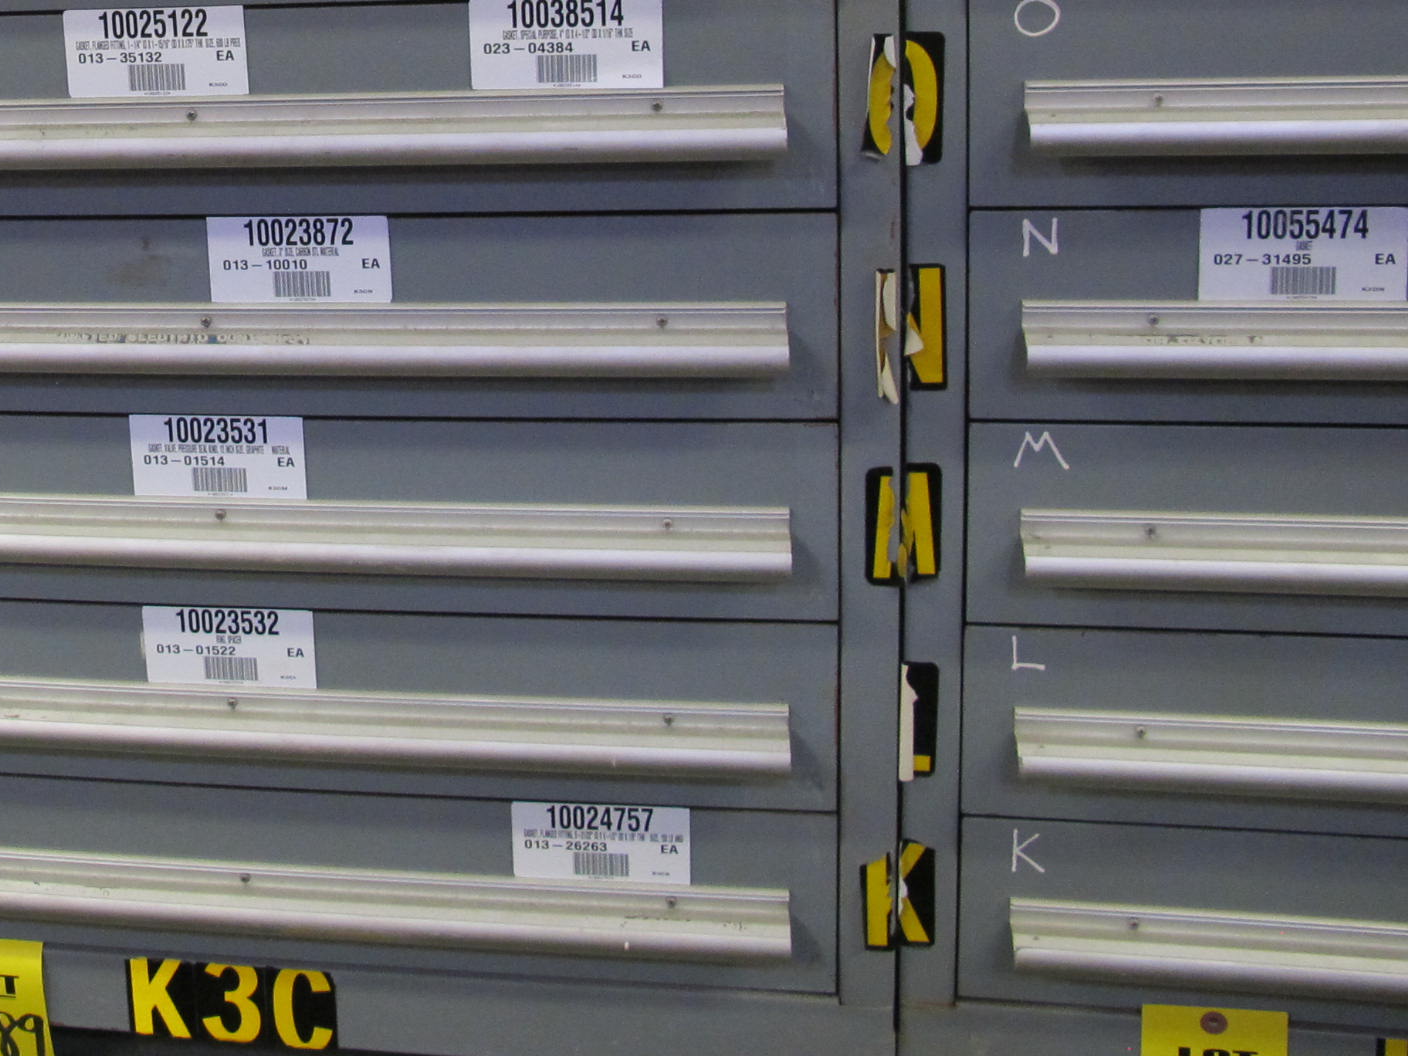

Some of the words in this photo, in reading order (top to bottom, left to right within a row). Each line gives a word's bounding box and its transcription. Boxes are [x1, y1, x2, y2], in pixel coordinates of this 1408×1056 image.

[98, 9, 208, 39] 10025122
[216, 50, 234, 61] EA
[632, 40, 651, 52] EA
[243, 217, 354, 246] 10023872
[1022, 218, 1058, 257] N
[1242, 209, 1369, 239] 10055474
[362, 258, 380, 269] EA
[1375, 253, 1396, 265] EA
[164, 416, 268, 444] 10023531
[277, 456, 295, 468] EA
[1014, 431, 1070, 470] M
[176, 609, 280, 635] 10023532
[287, 647, 304, 658] EA
[1011, 635, 1045, 670] L
[546, 805, 654, 832] 10024757
[660, 844, 679, 854] EA
[1011, 828, 1045, 873] K
[866, 842, 930, 946] K
[129, 956, 334, 1050] K3C
